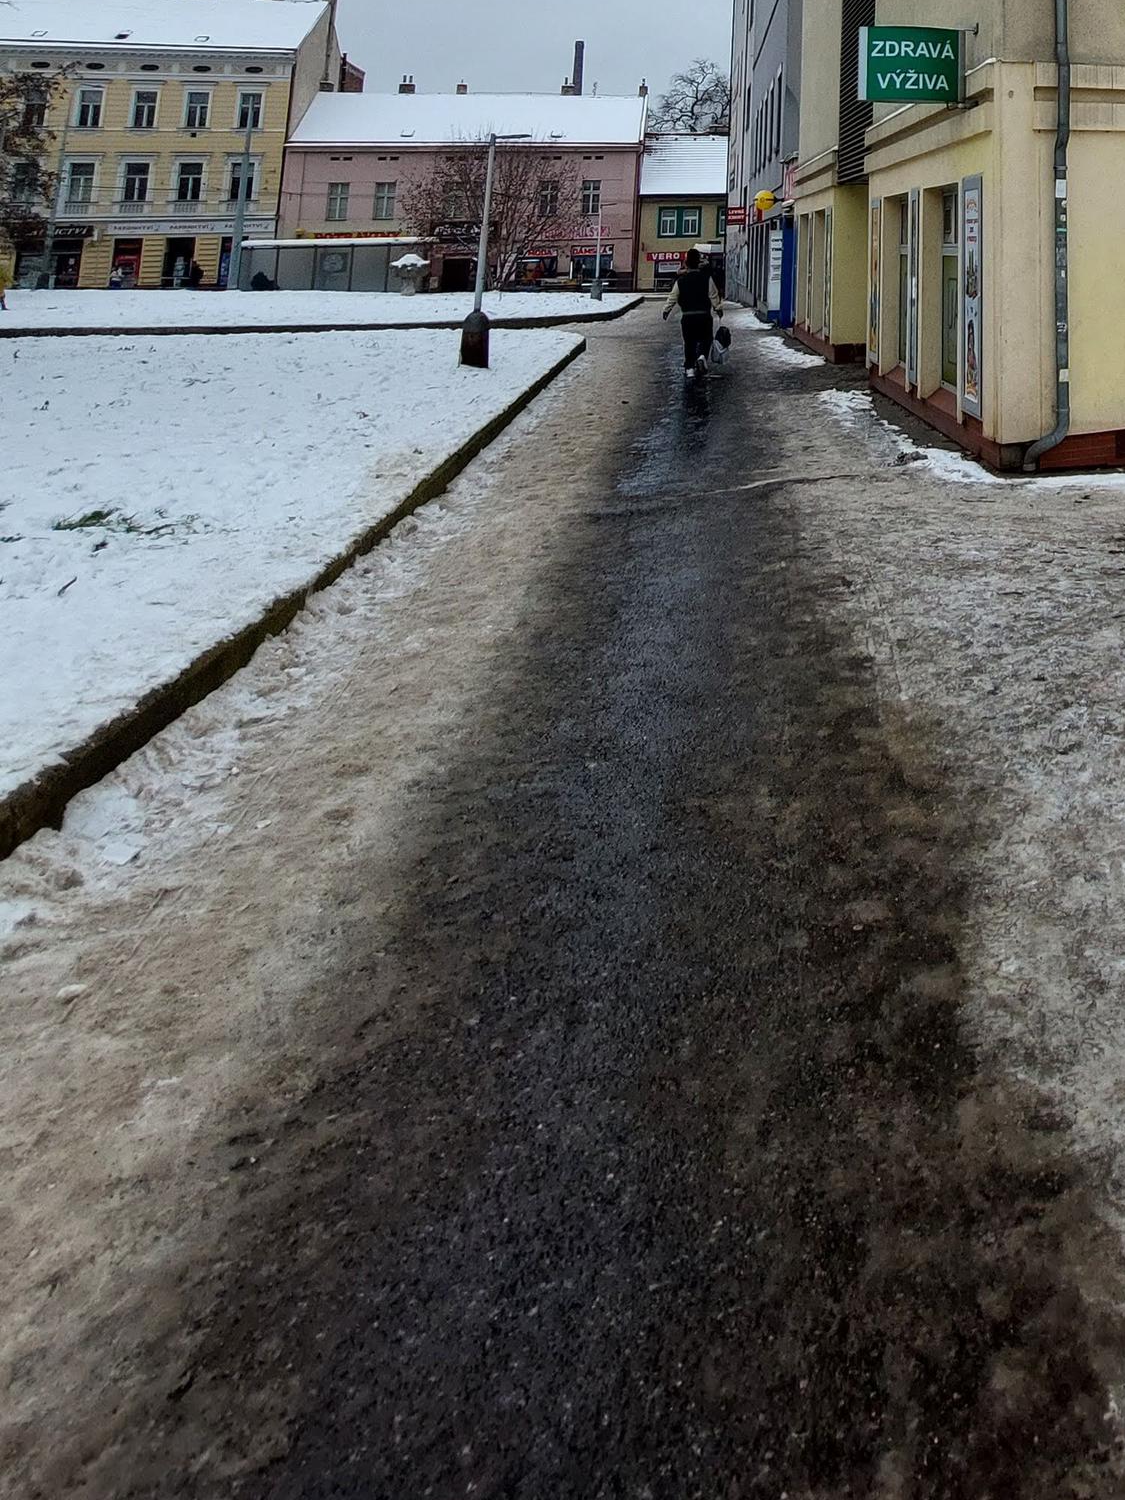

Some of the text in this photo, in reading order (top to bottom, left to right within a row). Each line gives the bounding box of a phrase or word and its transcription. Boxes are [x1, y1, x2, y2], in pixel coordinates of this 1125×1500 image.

[871, 39, 955, 60] ZDRAVÁ
[877, 69, 950, 91] VÝŽIVA
[651, 252, 680, 261] VERO
